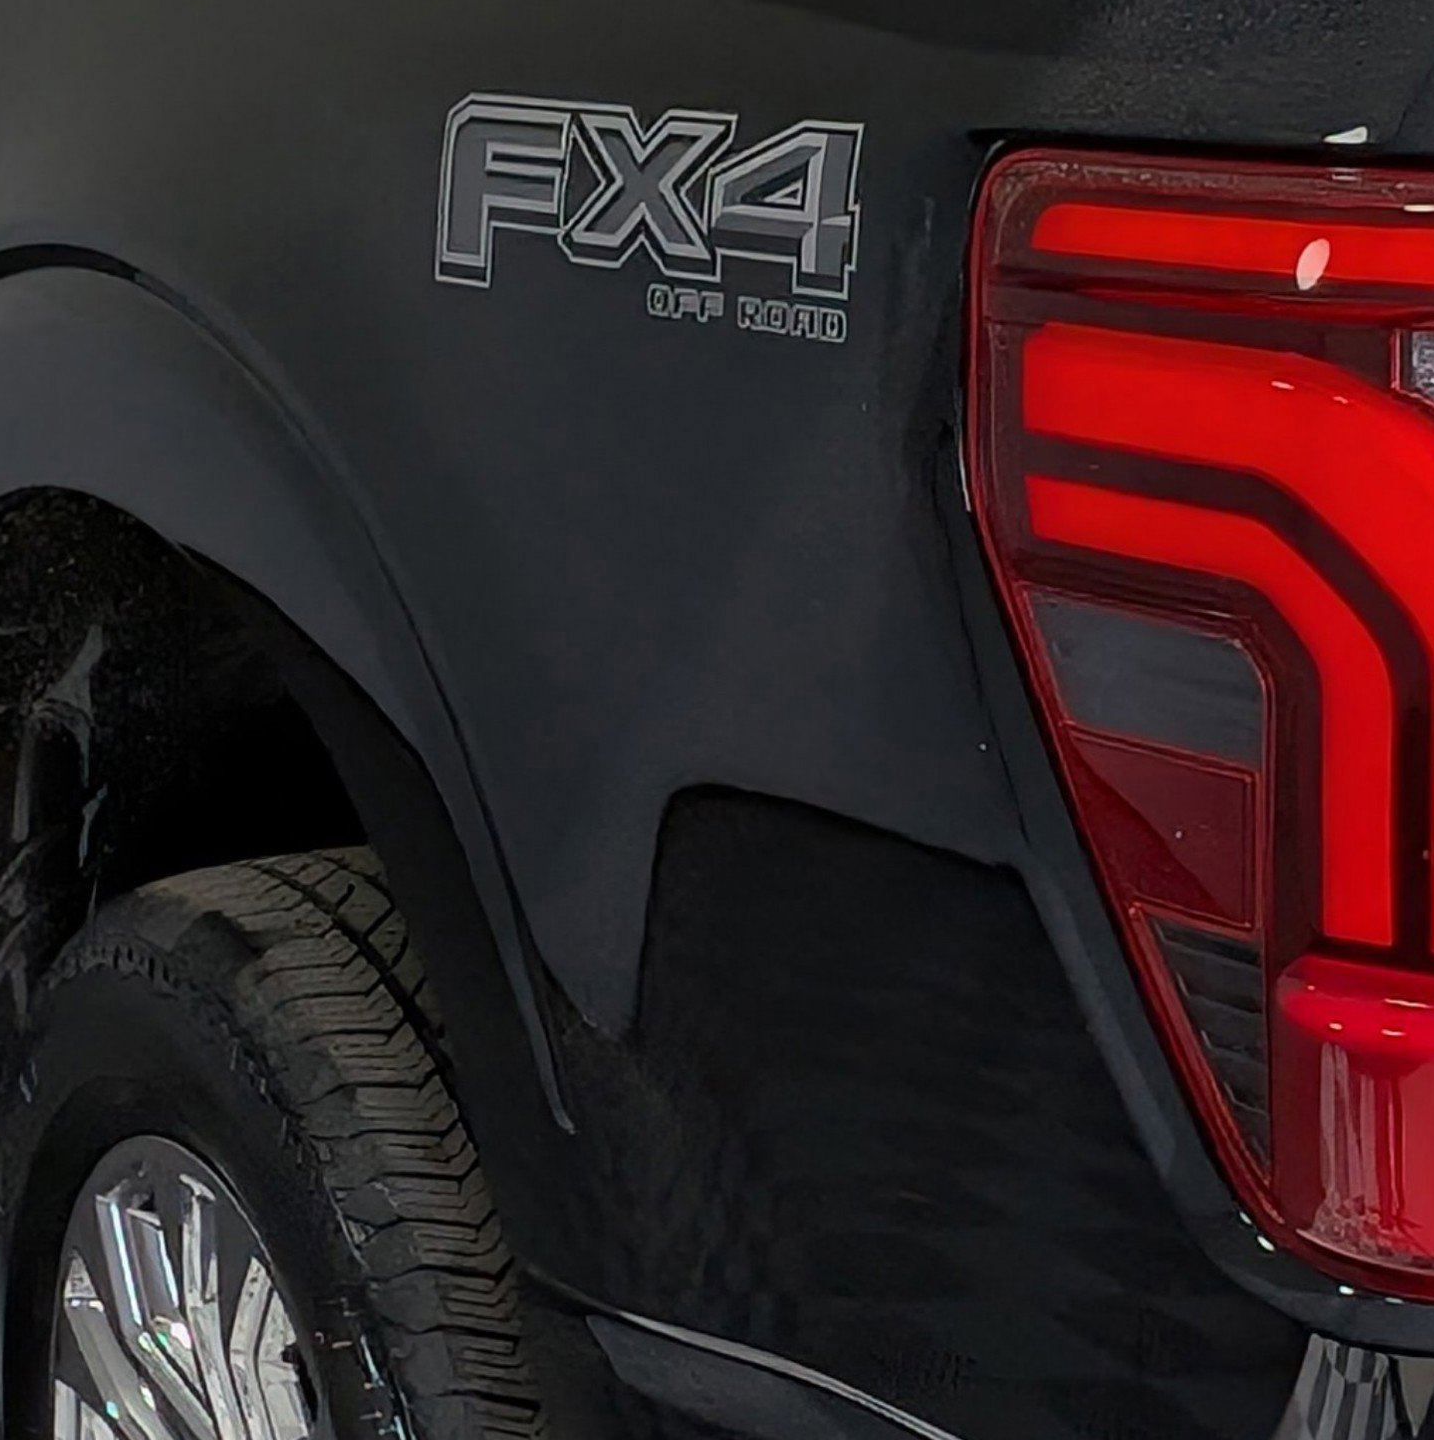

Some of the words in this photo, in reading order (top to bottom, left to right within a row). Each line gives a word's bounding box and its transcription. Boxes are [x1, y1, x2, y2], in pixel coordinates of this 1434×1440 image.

[435, 92, 864, 300] FX4
[646, 283, 724, 323] OFF
[736, 295, 848, 343] ROAD
